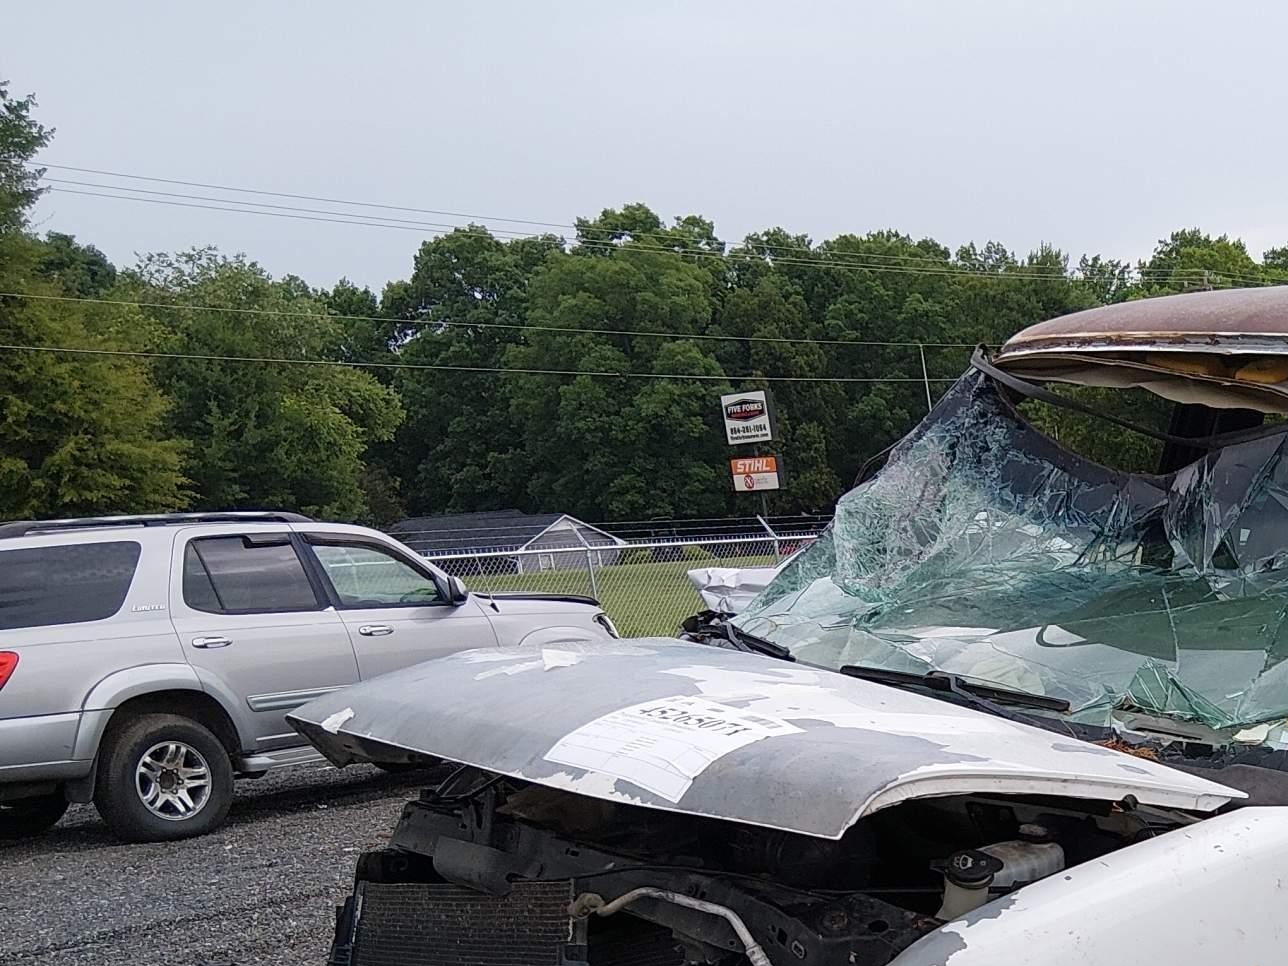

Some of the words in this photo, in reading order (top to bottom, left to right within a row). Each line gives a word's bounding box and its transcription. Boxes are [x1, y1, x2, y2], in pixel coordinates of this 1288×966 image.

[728, 405, 742, 414] FIVE
[742, 403, 762, 411] FORKS
[736, 460, 771, 472] STIHL
[639, 707, 752, 736] 45265071
